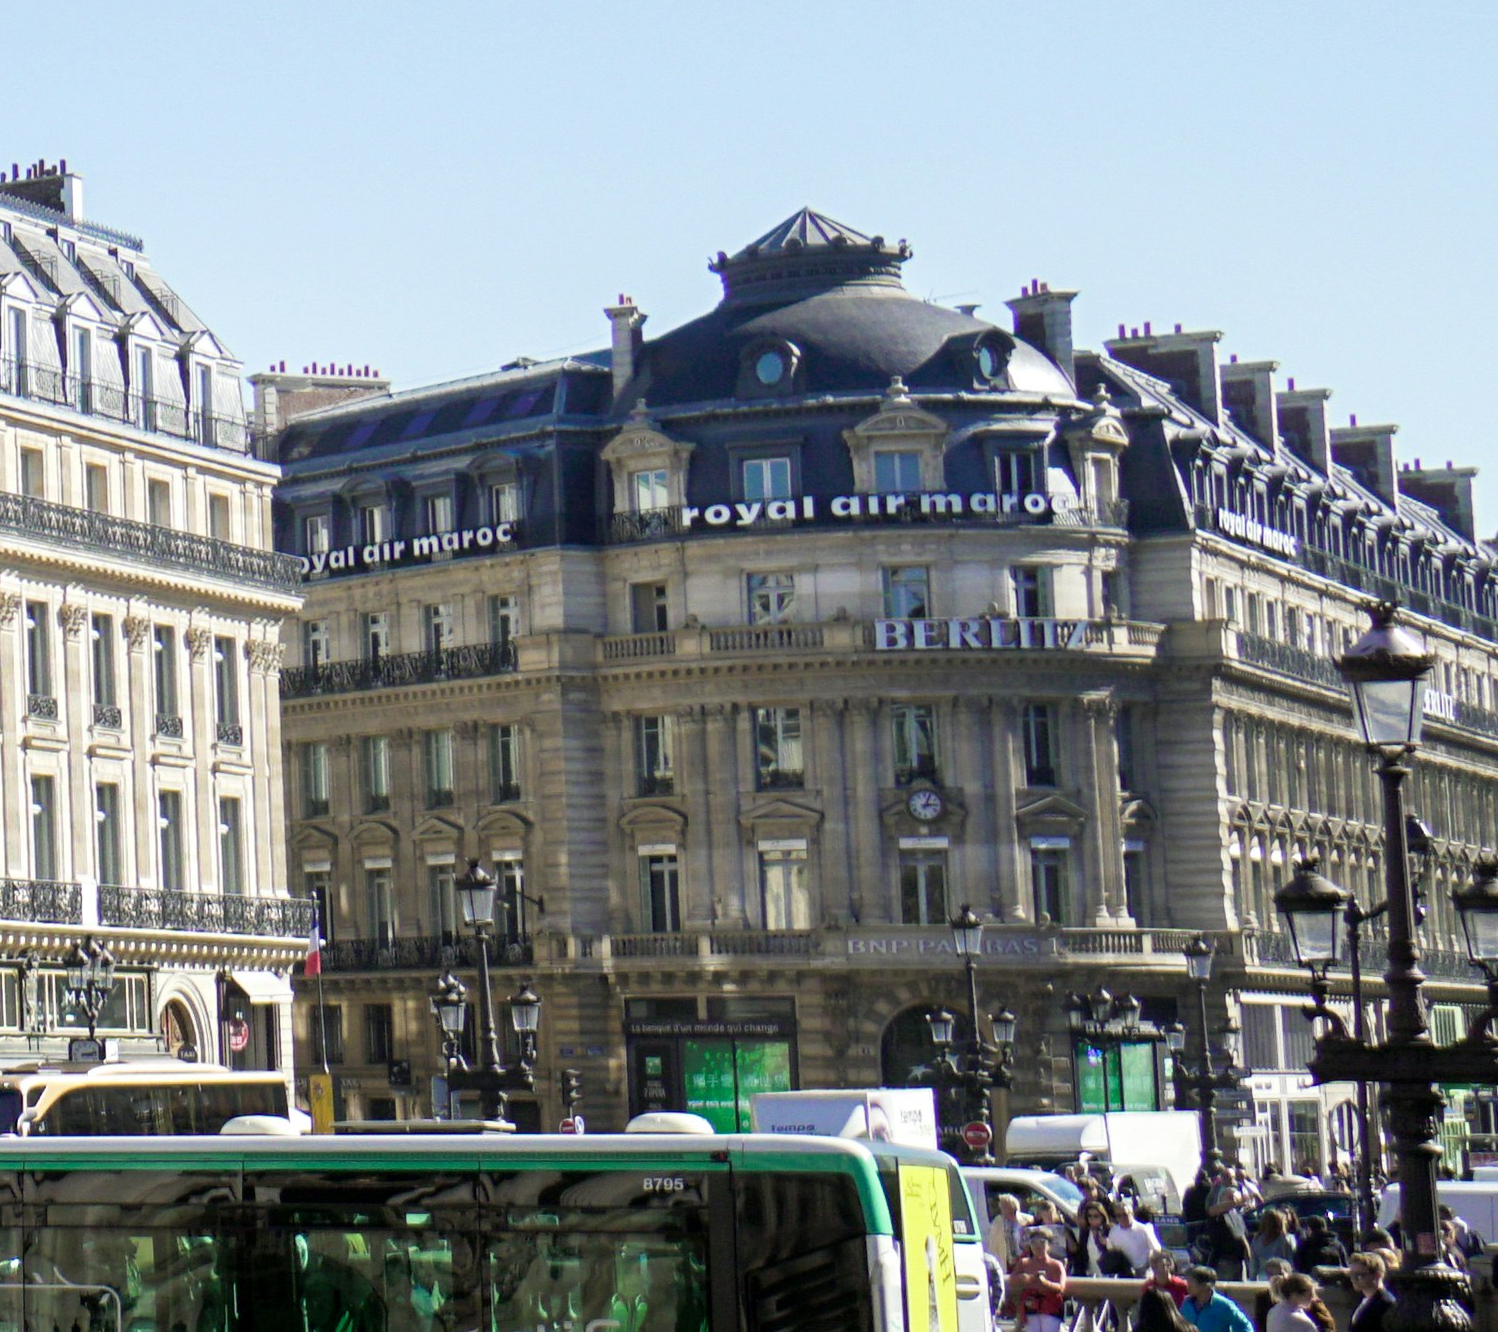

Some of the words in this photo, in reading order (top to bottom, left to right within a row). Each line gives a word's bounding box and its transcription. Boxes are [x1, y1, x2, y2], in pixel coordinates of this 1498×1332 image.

[681, 493, 815, 526] royal
[831, 493, 906, 516] air
[920, 492, 1079, 515] maroc
[302, 545, 355, 574] oyal
[363, 540, 405, 564] air
[413, 522, 512, 556] maroc
[1218, 507, 1245, 537] royal
[1247, 518, 1262, 545] air
[1263, 526, 1297, 558] maroc
[874, 618, 1090, 651] BERLITZ
[847, 939, 908, 954] BNP
[918, 938, 1038, 954] PABAS
[727, 1023, 742, 1035] qui
[642, 1177, 685, 1192] 8795
